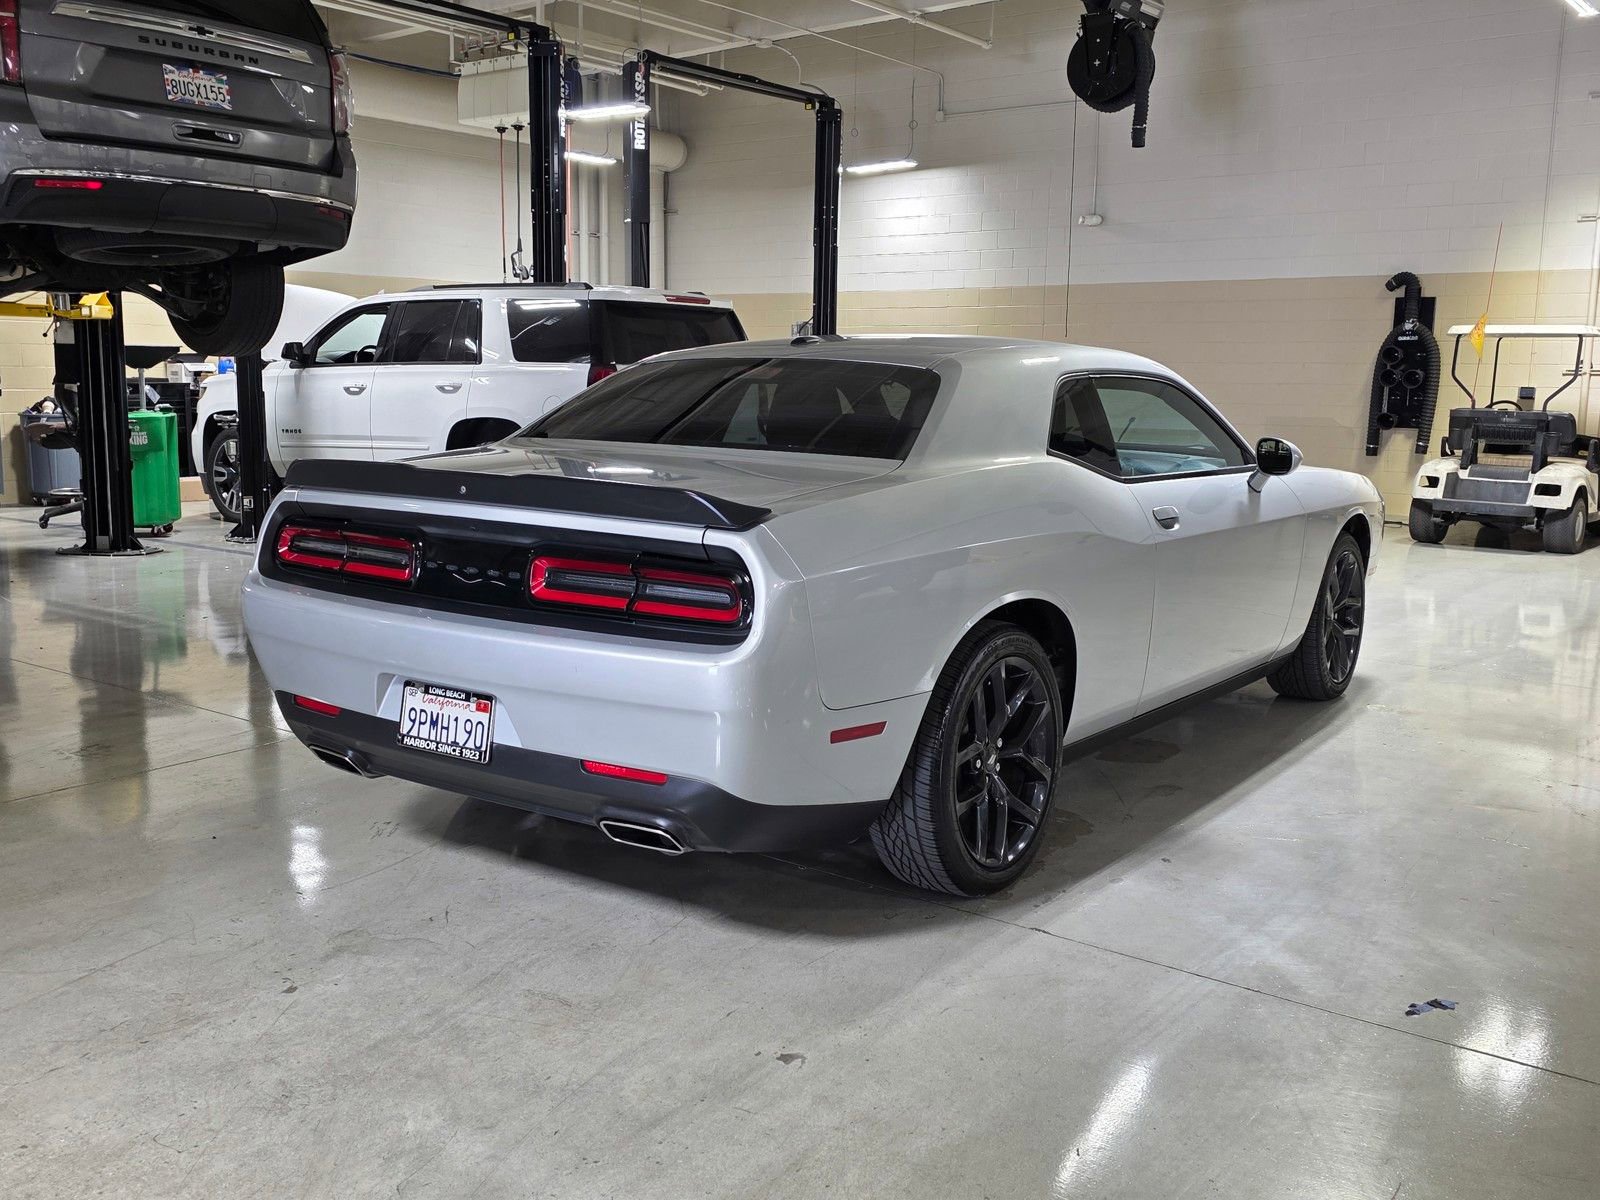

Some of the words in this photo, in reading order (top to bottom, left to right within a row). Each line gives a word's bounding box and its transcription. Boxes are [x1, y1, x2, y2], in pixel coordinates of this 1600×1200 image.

[138, 35, 259, 64] SUBURBAN
[178, 70, 216, 83] California
[170, 79, 226, 103] 8UGX155
[634, 92, 645, 150] ROTAY
[422, 694, 475, 712] California
[429, 687, 446, 696] LONG
[446, 689, 465, 699] BEACH
[406, 706, 485, 750] 9PMH190
[403, 736, 437, 752] HARBOR
[437, 743, 462, 756] SINCE
[461, 748, 480, 760] 1923
